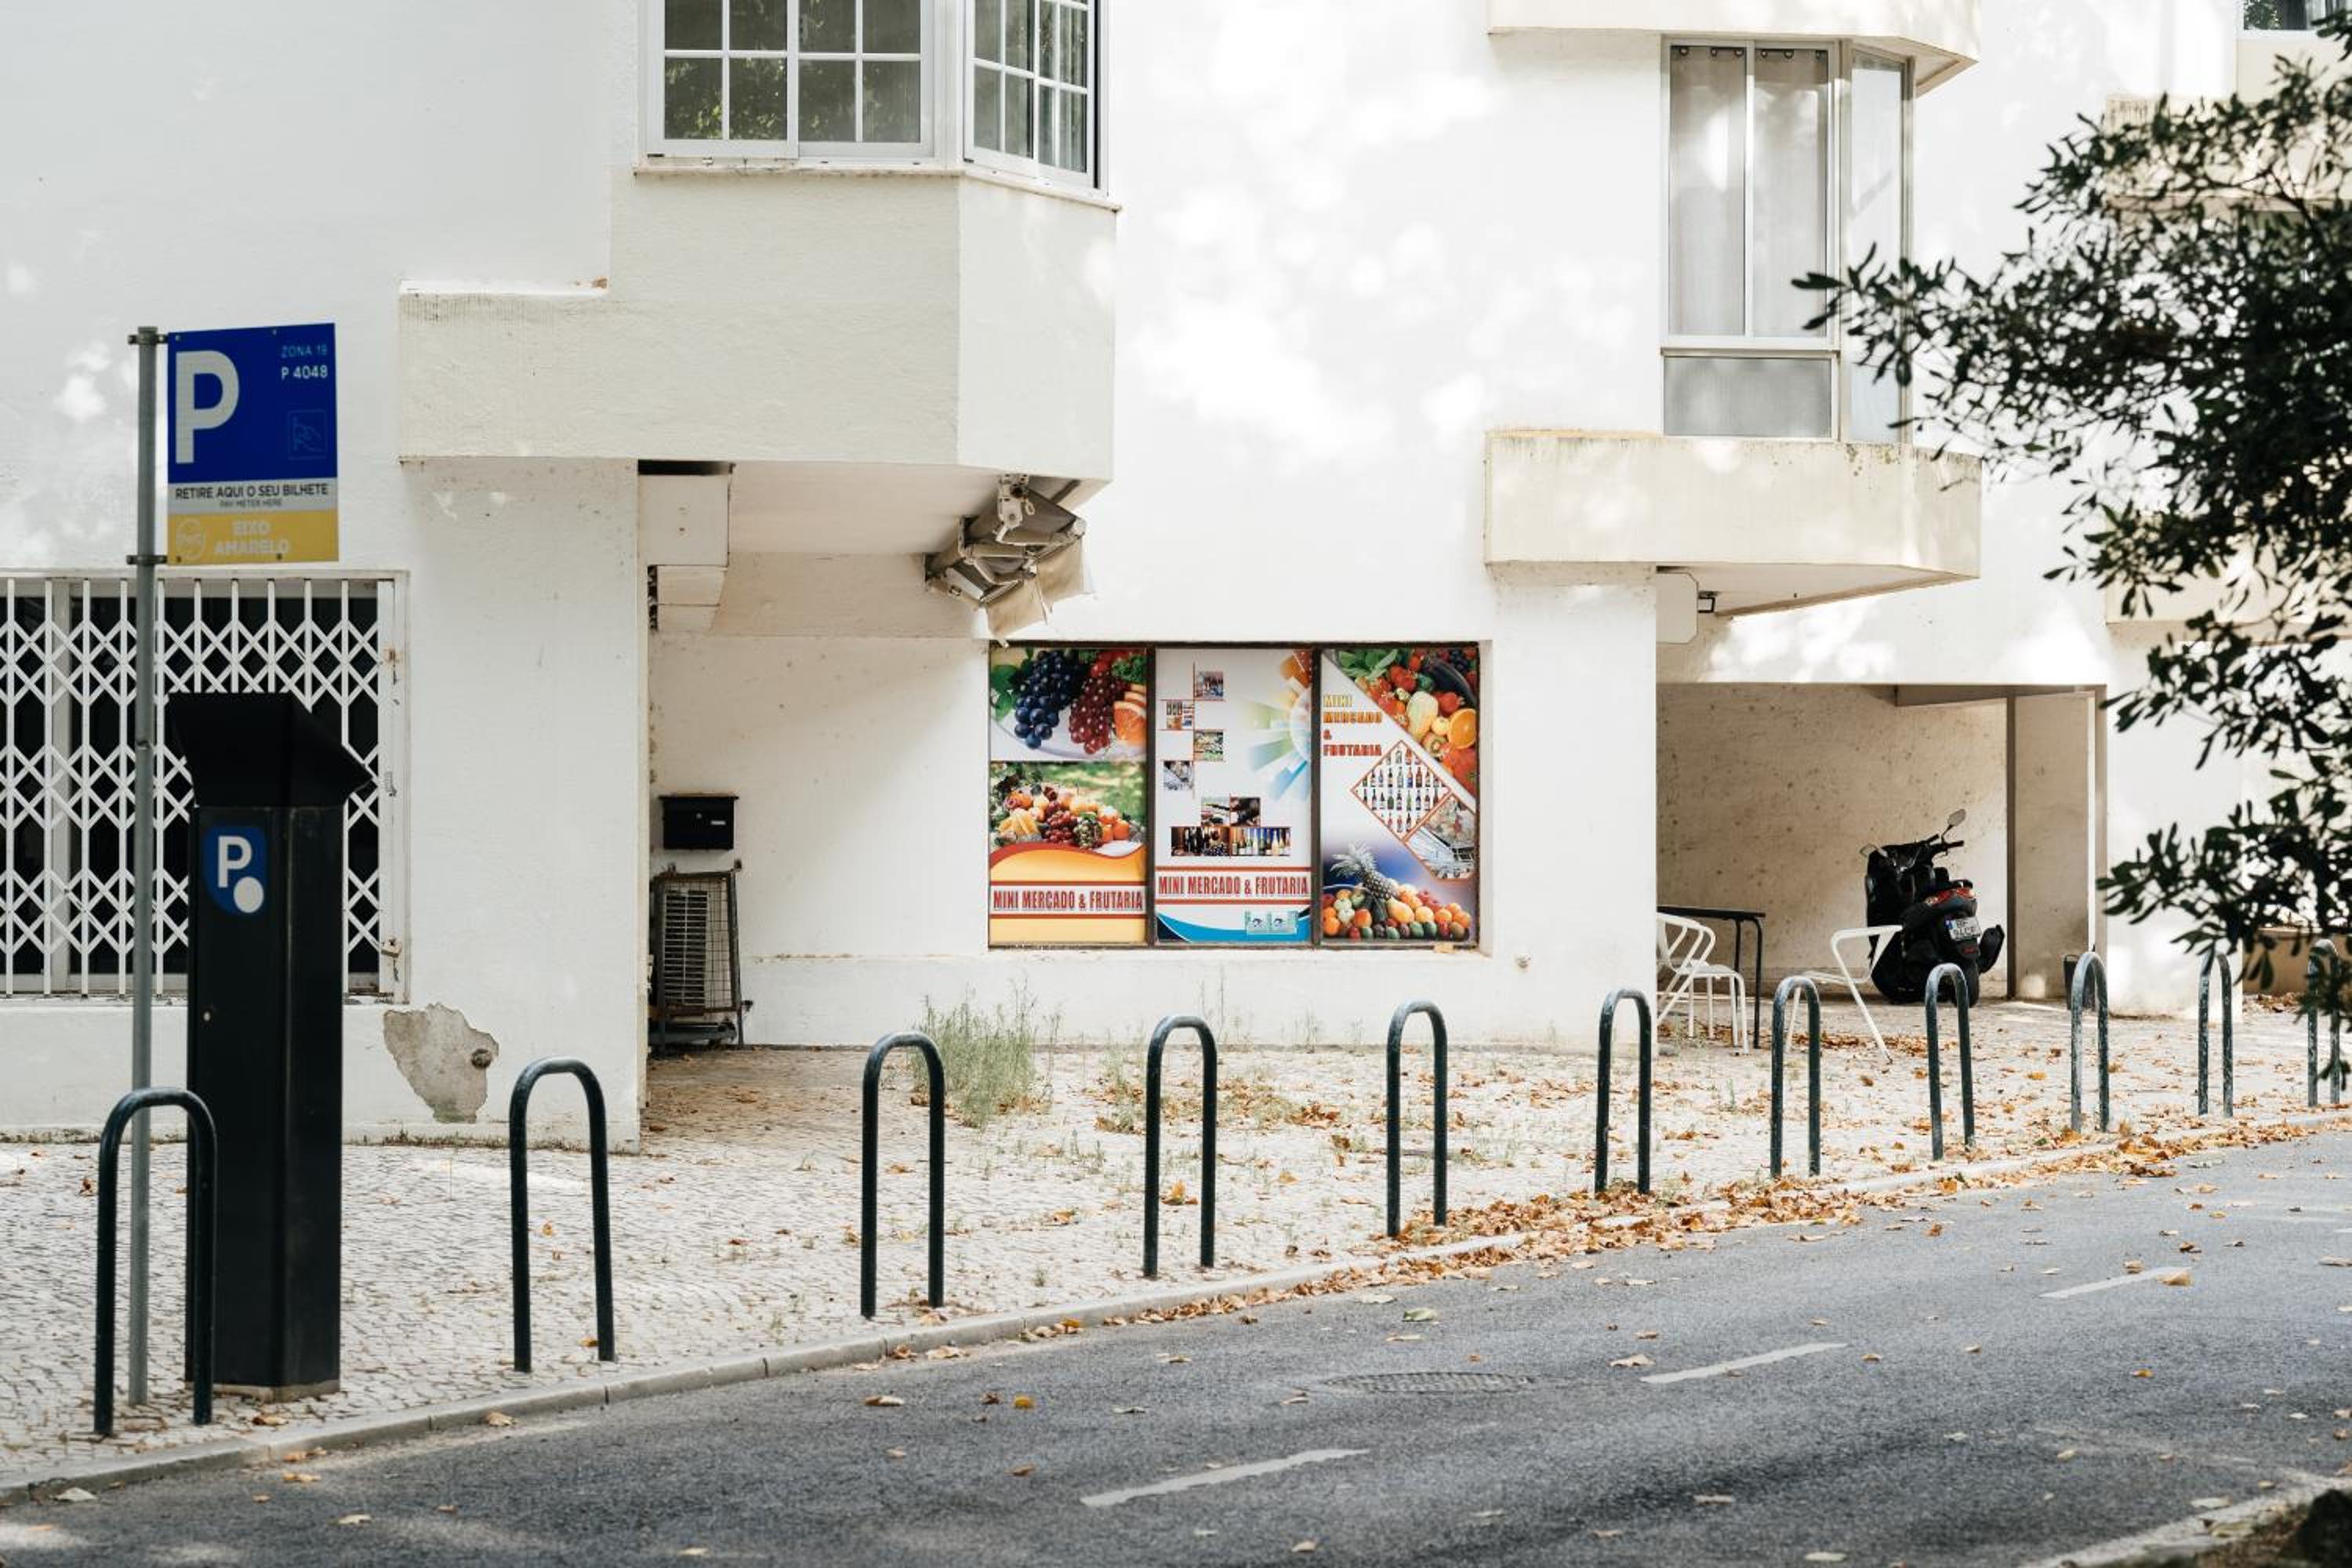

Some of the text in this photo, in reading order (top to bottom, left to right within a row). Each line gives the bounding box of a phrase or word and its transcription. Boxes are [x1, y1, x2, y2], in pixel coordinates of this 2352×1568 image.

[281, 344, 314, 358] ZONA
[281, 365, 328, 381] P 4048
[176, 350, 239, 464] P
[175, 483, 328, 499] RETIRE AQUI O SEU BILHETE
[1323, 694, 1352, 707] MINI
[1323, 744, 1382, 757] FRUTARIA
[217, 836, 252, 888] P
[1159, 876, 1309, 895] MINI MERCADO & FRUTARIA
[993, 890, 1143, 909] MINI MERCADO & FRUTARIA
